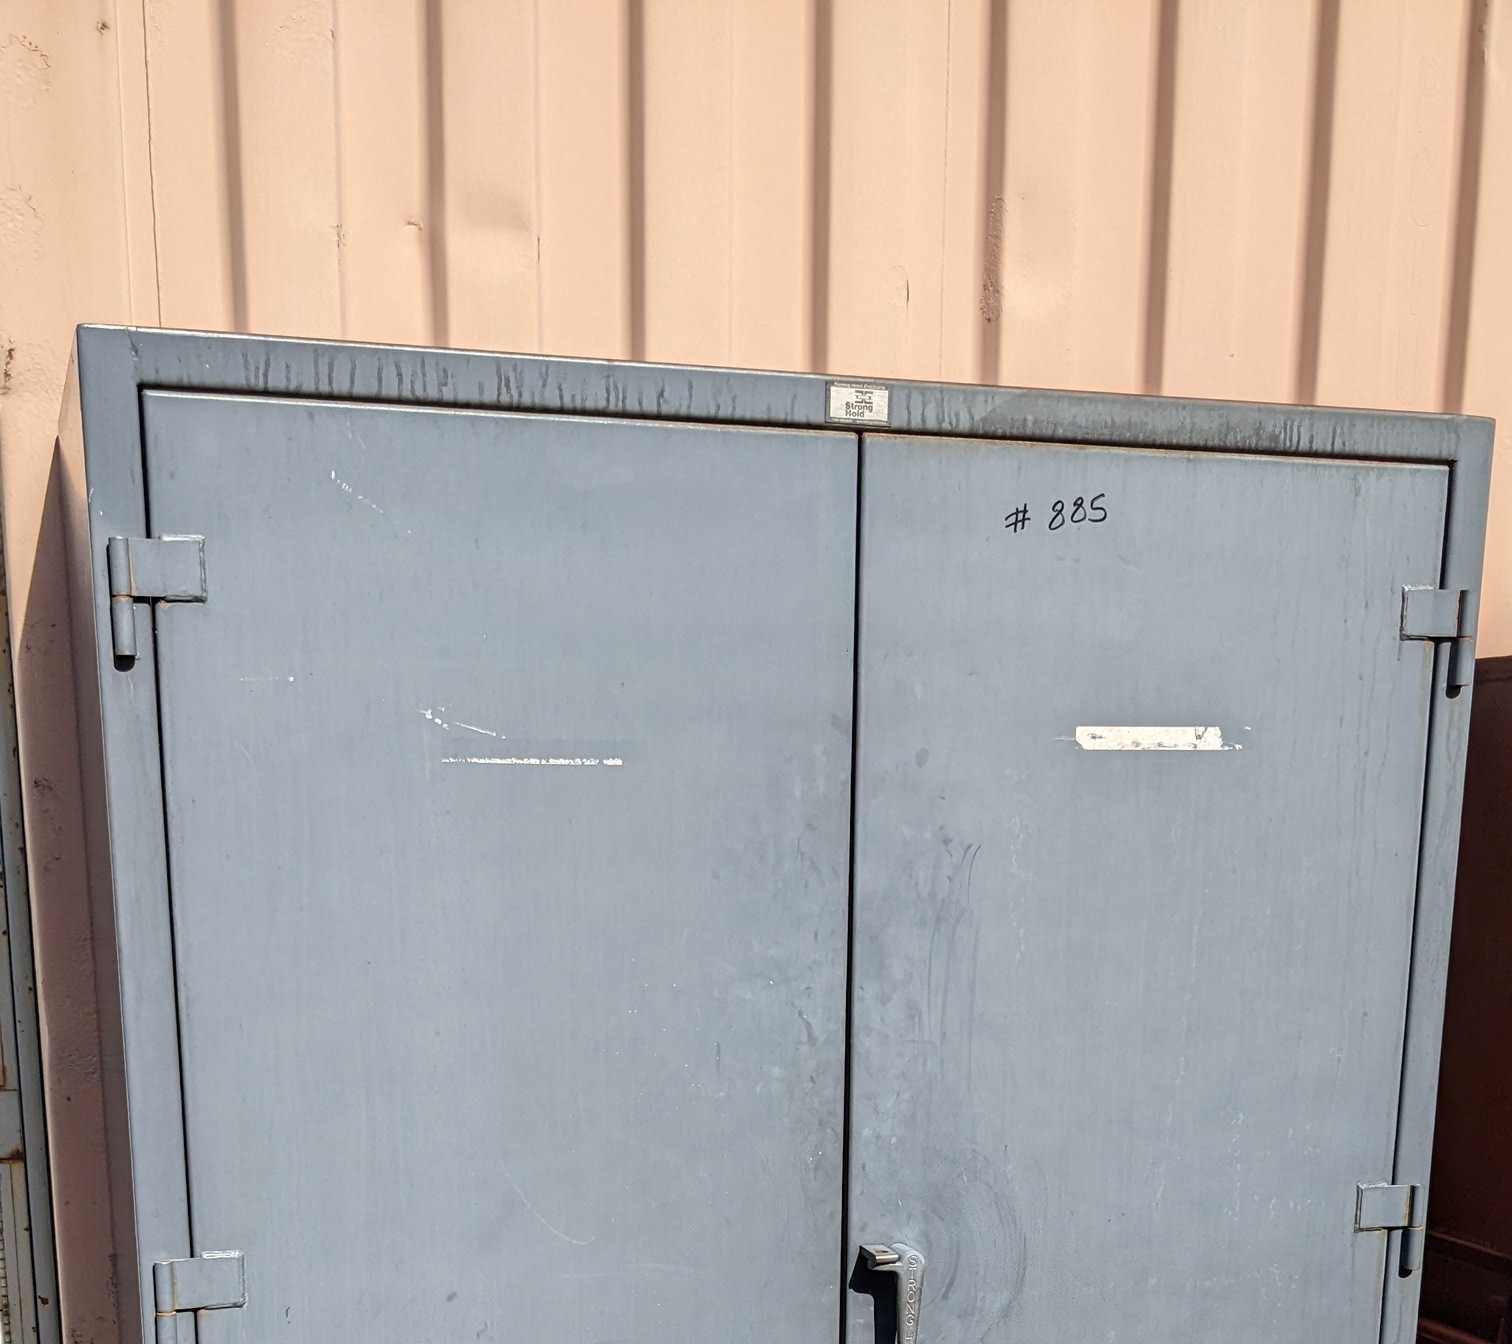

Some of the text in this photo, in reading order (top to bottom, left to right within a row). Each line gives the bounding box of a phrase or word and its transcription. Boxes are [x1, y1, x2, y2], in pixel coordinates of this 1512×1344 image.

[845, 401, 873, 413] Strong
[845, 409, 865, 418] Hold
[1004, 493, 1107, 533] # 885
[905, 1254, 919, 1326] STRONG
